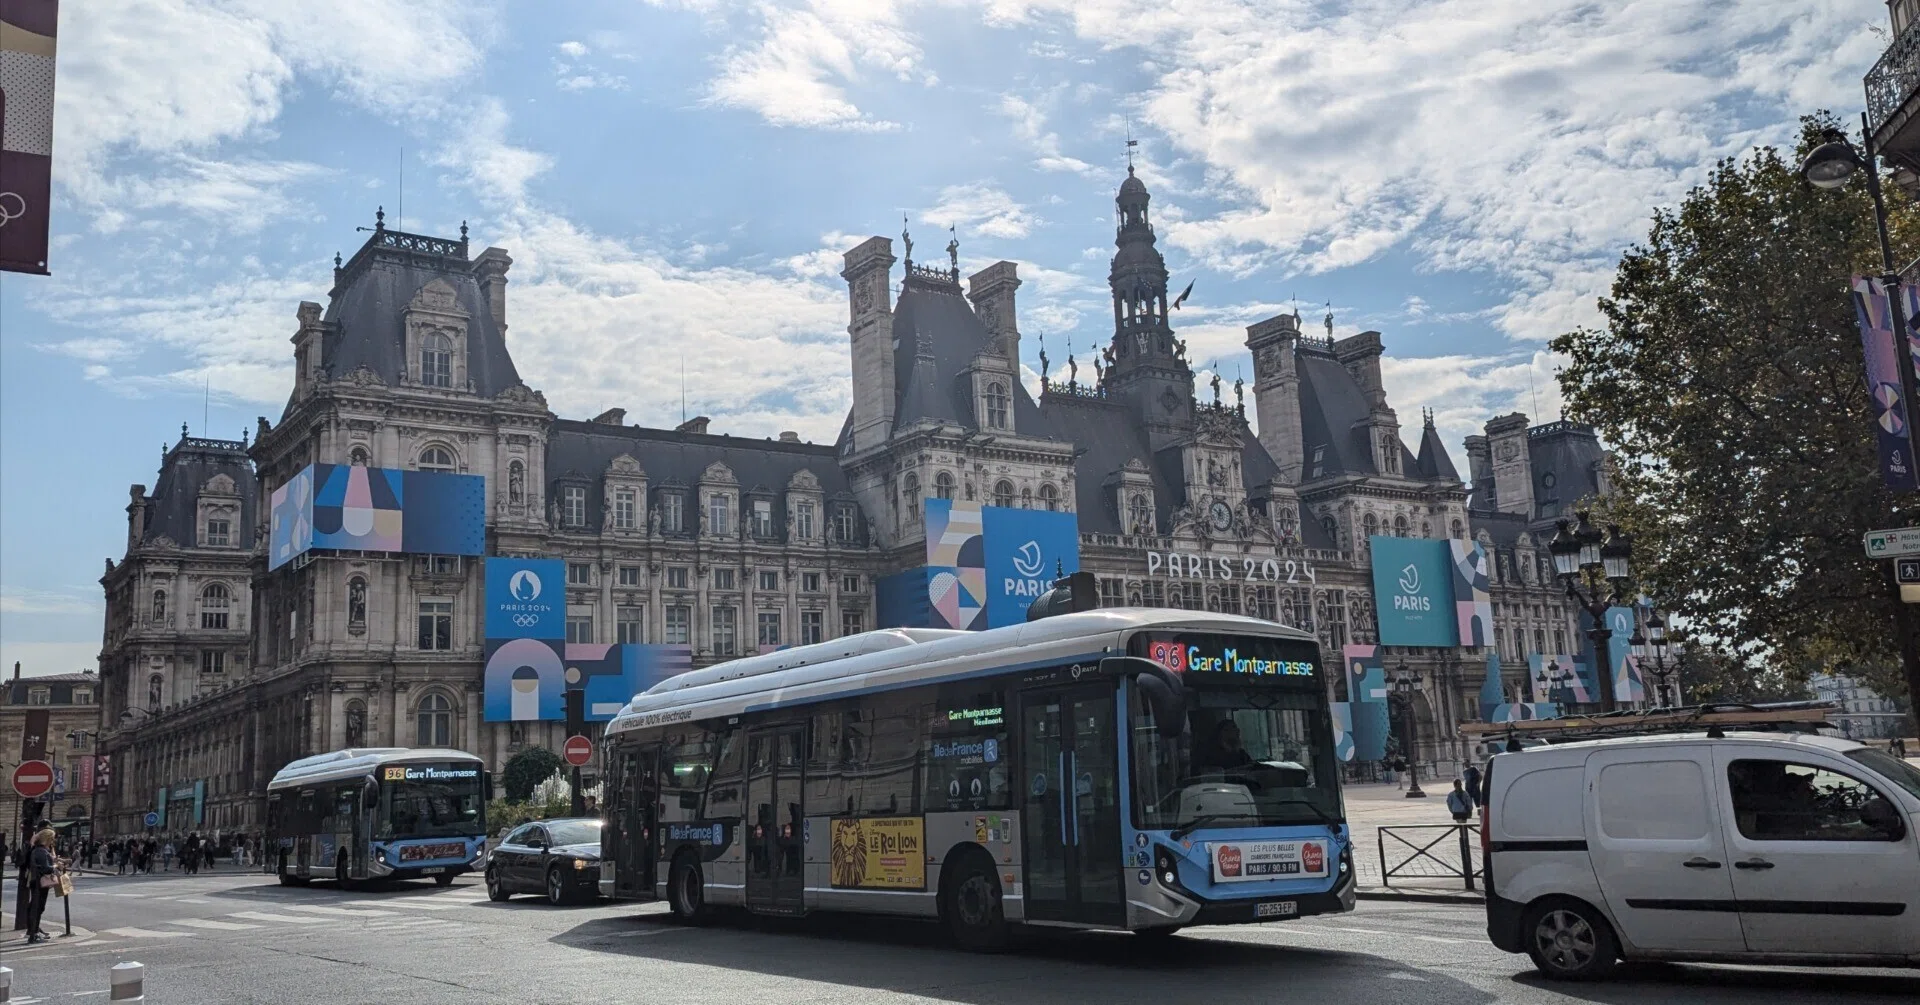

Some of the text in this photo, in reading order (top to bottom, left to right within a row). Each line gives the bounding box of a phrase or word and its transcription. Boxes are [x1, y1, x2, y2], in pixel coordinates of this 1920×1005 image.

[1890, 464, 1907, 474] PARIS
[1243, 557, 1316, 585] 2024
[527, 604, 551, 612] 2024
[1394, 595, 1431, 611] PARIS
[1155, 644, 1314, 676] 96 Gare Montparnasse
[621, 709, 692, 729] véhicule 100% électrique
[948, 707, 1002, 720] Gare Montparnasse
[388, 767, 477, 779] 96 Gare Montparnasse
[870, 832, 917, 854] LE ROI LION
[1250, 844, 1295, 853] LES PLUS BELLES
[1248, 864, 1267, 874] PARIS
[1272, 863, 1287, 873] 90.9
[1288, 863, 1297, 872] FM
